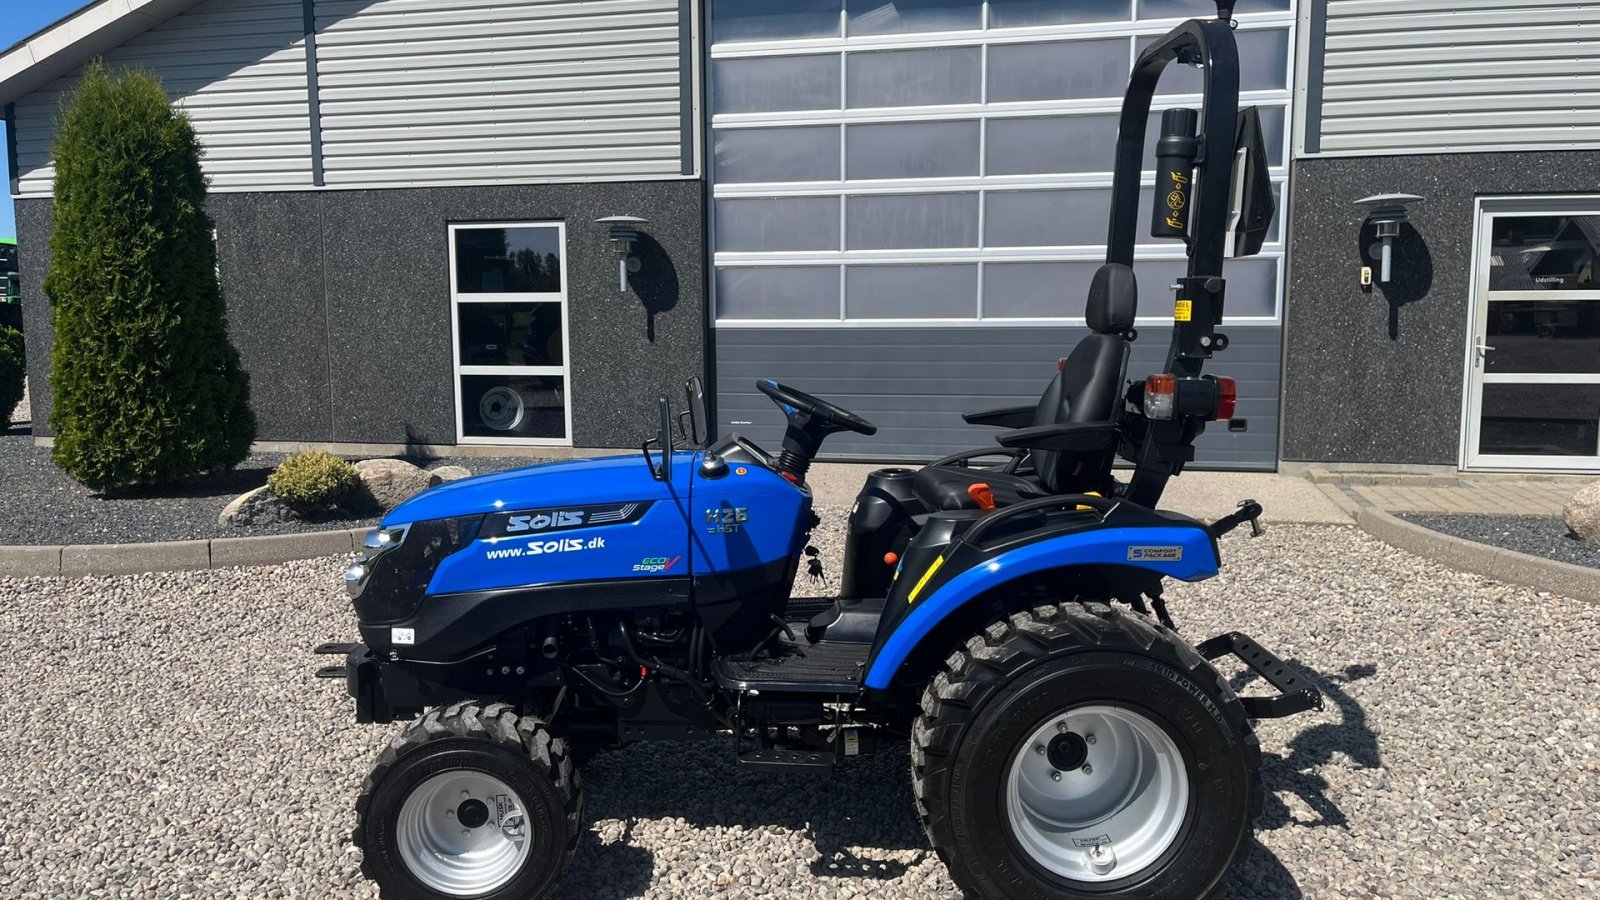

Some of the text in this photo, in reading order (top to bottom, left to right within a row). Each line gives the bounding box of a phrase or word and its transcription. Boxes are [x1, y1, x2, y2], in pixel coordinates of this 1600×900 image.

[706, 507, 748, 524] H26
[1151, 663, 1175, 680] SKID
[1175, 675, 1209, 706] POWER
